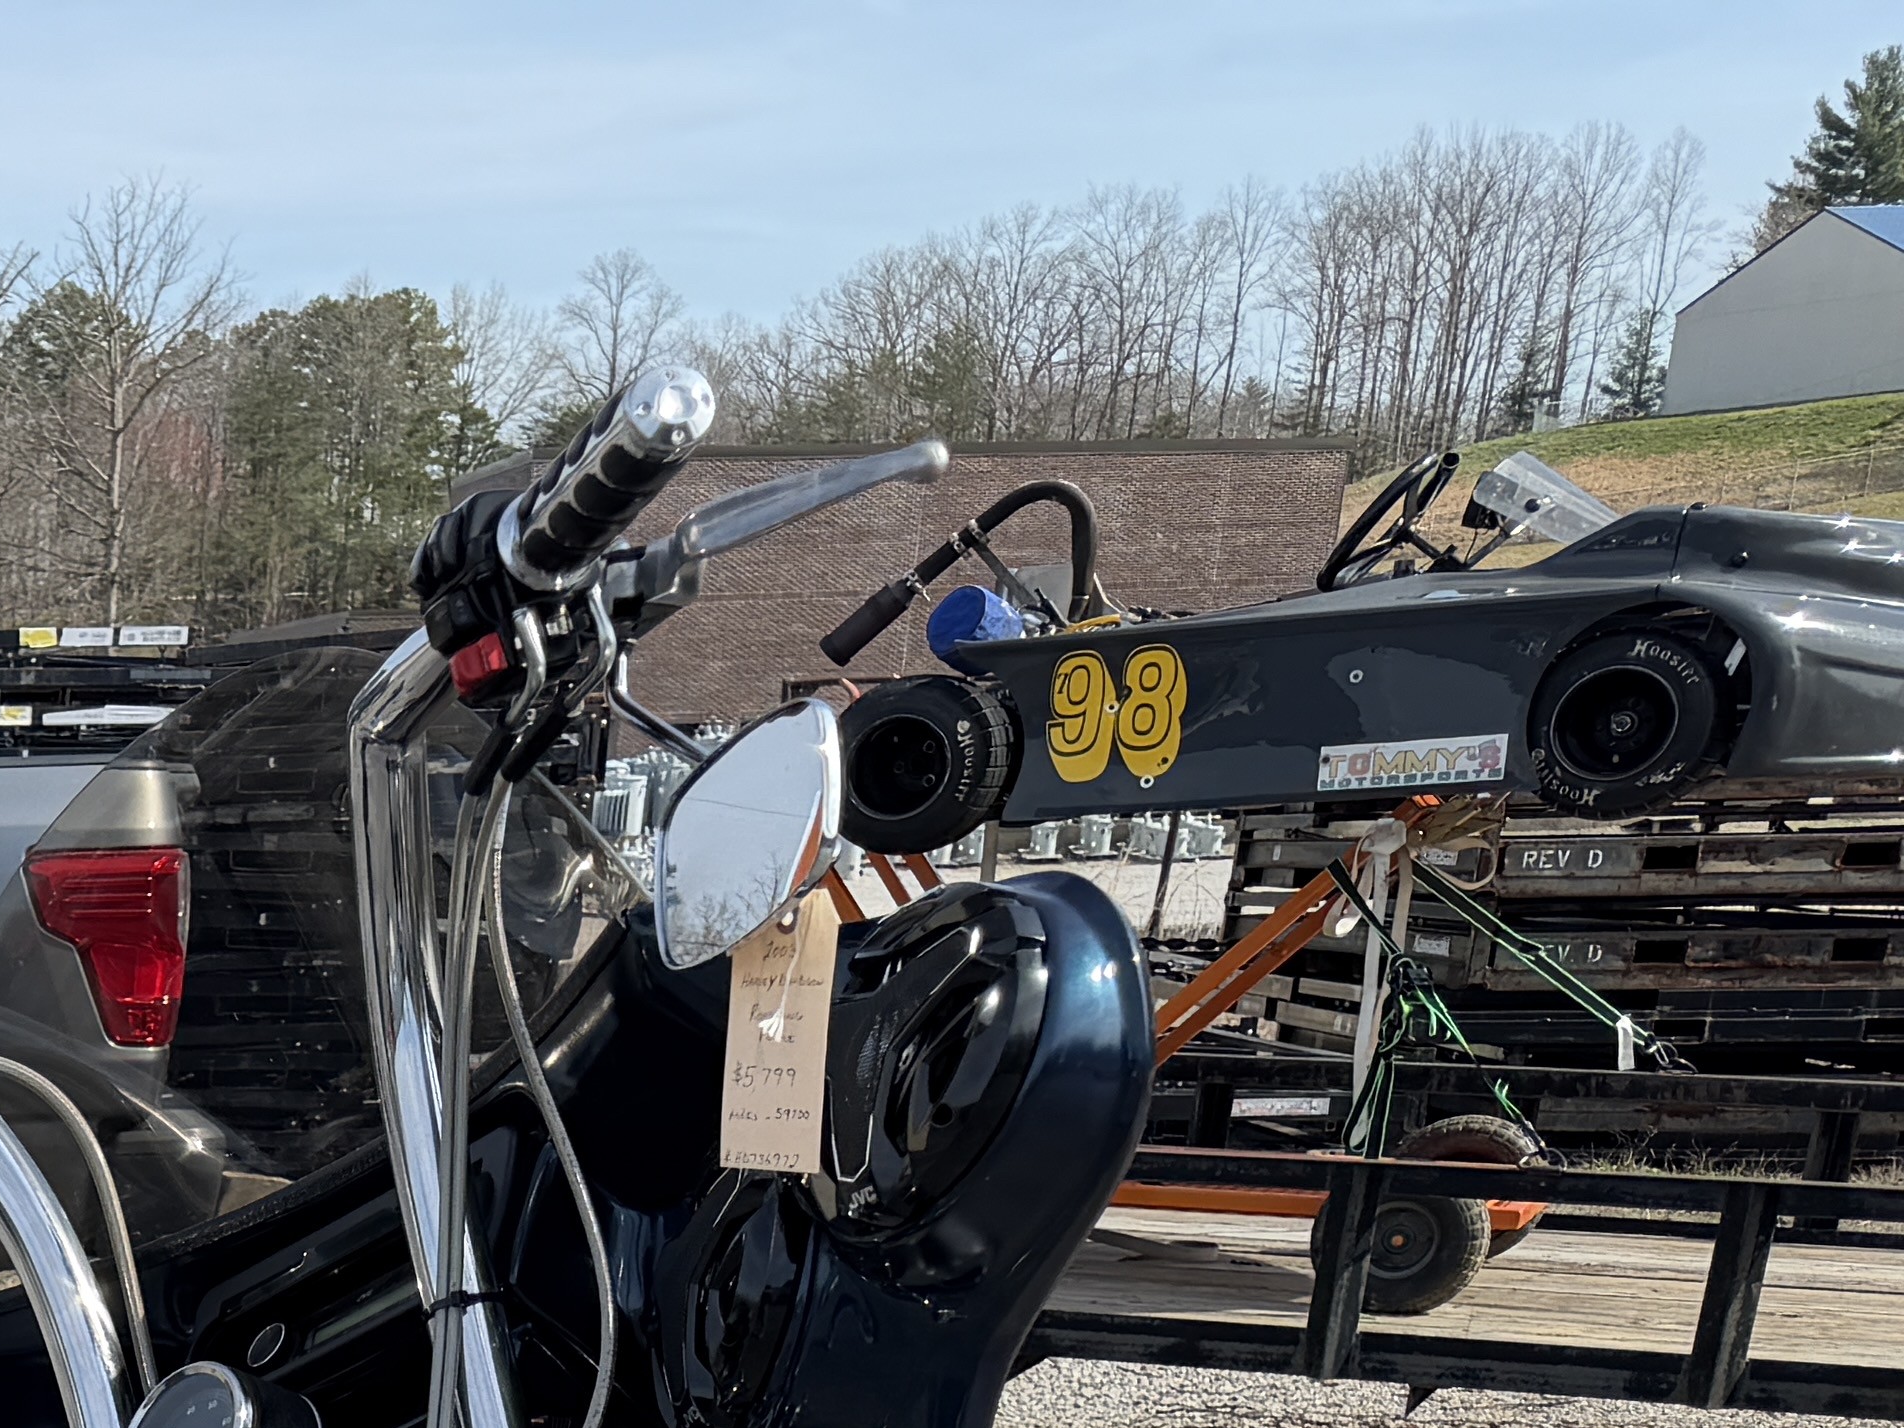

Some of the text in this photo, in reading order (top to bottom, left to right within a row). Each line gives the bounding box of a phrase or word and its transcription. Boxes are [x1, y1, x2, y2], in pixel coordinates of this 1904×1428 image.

[1046, 643, 1188, 783] 98
[1328, 738, 1502, 779] TOMMY'S
[1319, 767, 1502, 790] MOTORSPORTS
[1521, 849, 1604, 870] REV D
[1588, 944, 1603, 963] D
[732, 1061, 797, 1094] $5,799
[848, 1185, 878, 1210] JVC
